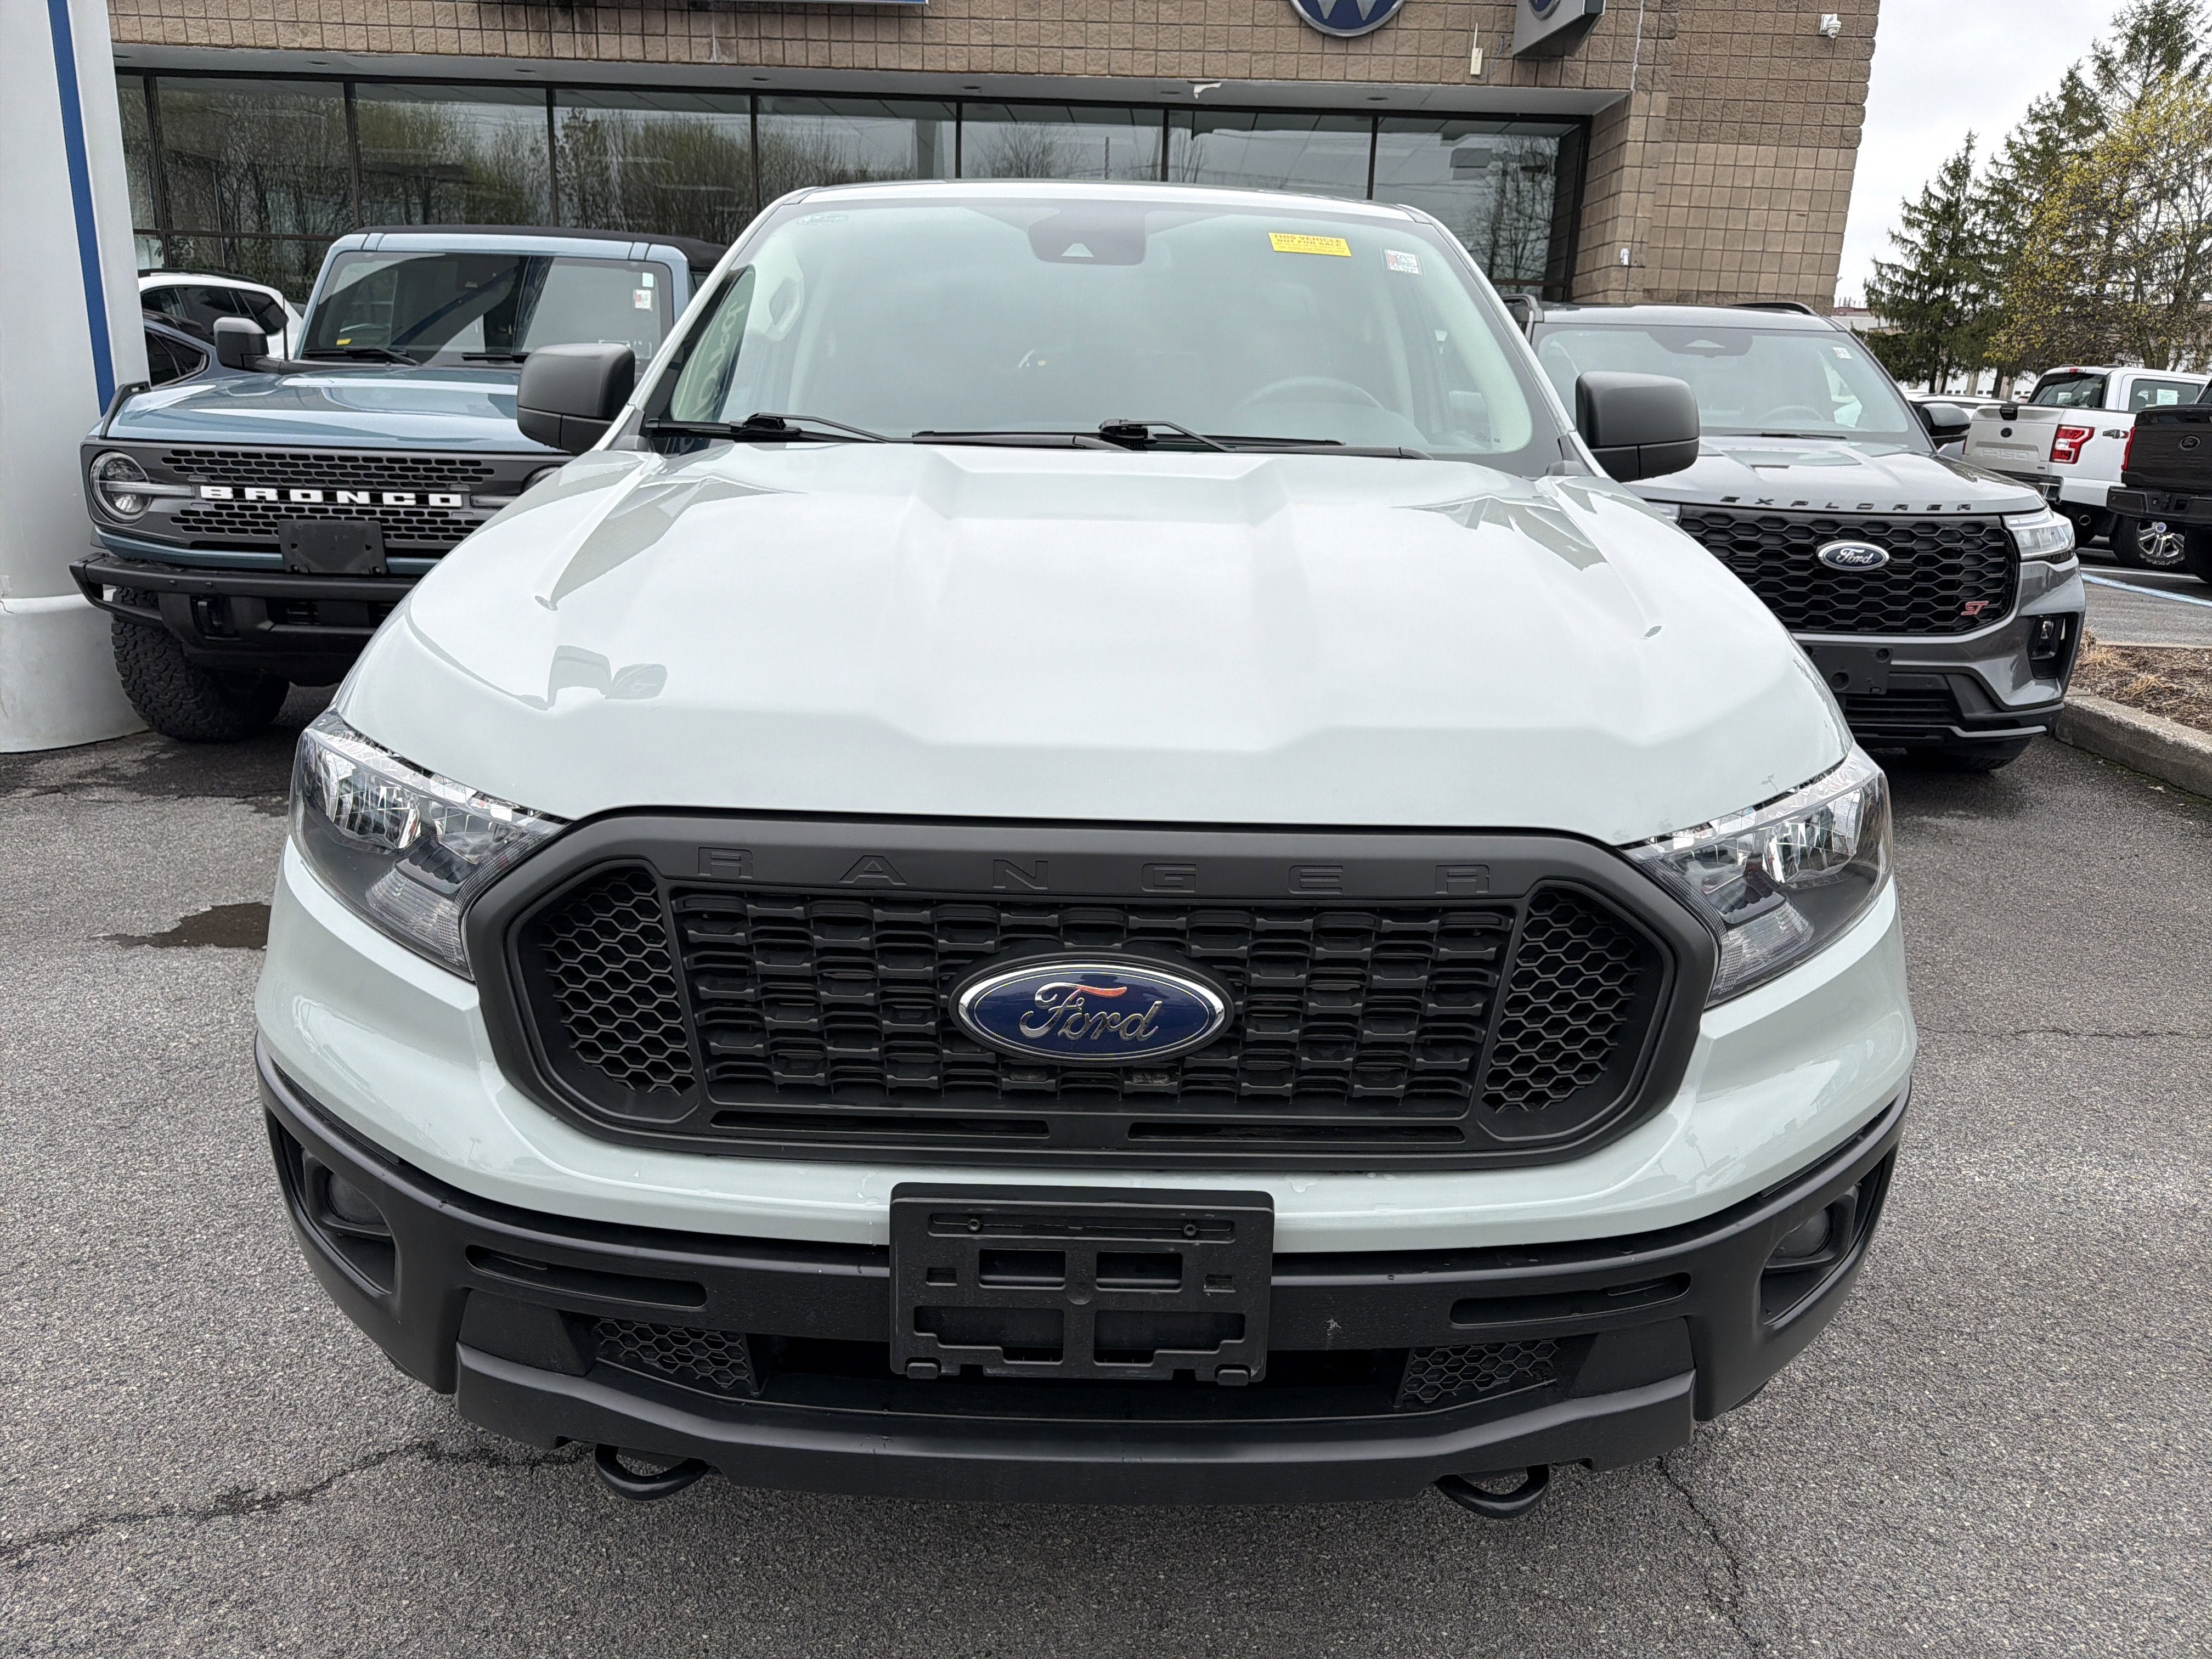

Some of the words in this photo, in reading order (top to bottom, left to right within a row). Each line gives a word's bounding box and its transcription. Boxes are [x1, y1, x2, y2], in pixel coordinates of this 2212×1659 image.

[1299, 235, 1342, 244] VEHICLE
[200, 485, 462, 507] BRONCO
[1720, 495, 1973, 511] EXPLORER
[1836, 549, 1873, 565] Ford
[1960, 600, 1989, 616] ST
[697, 847, 1491, 896] RANGER
[1019, 982, 1163, 1040] Ford
